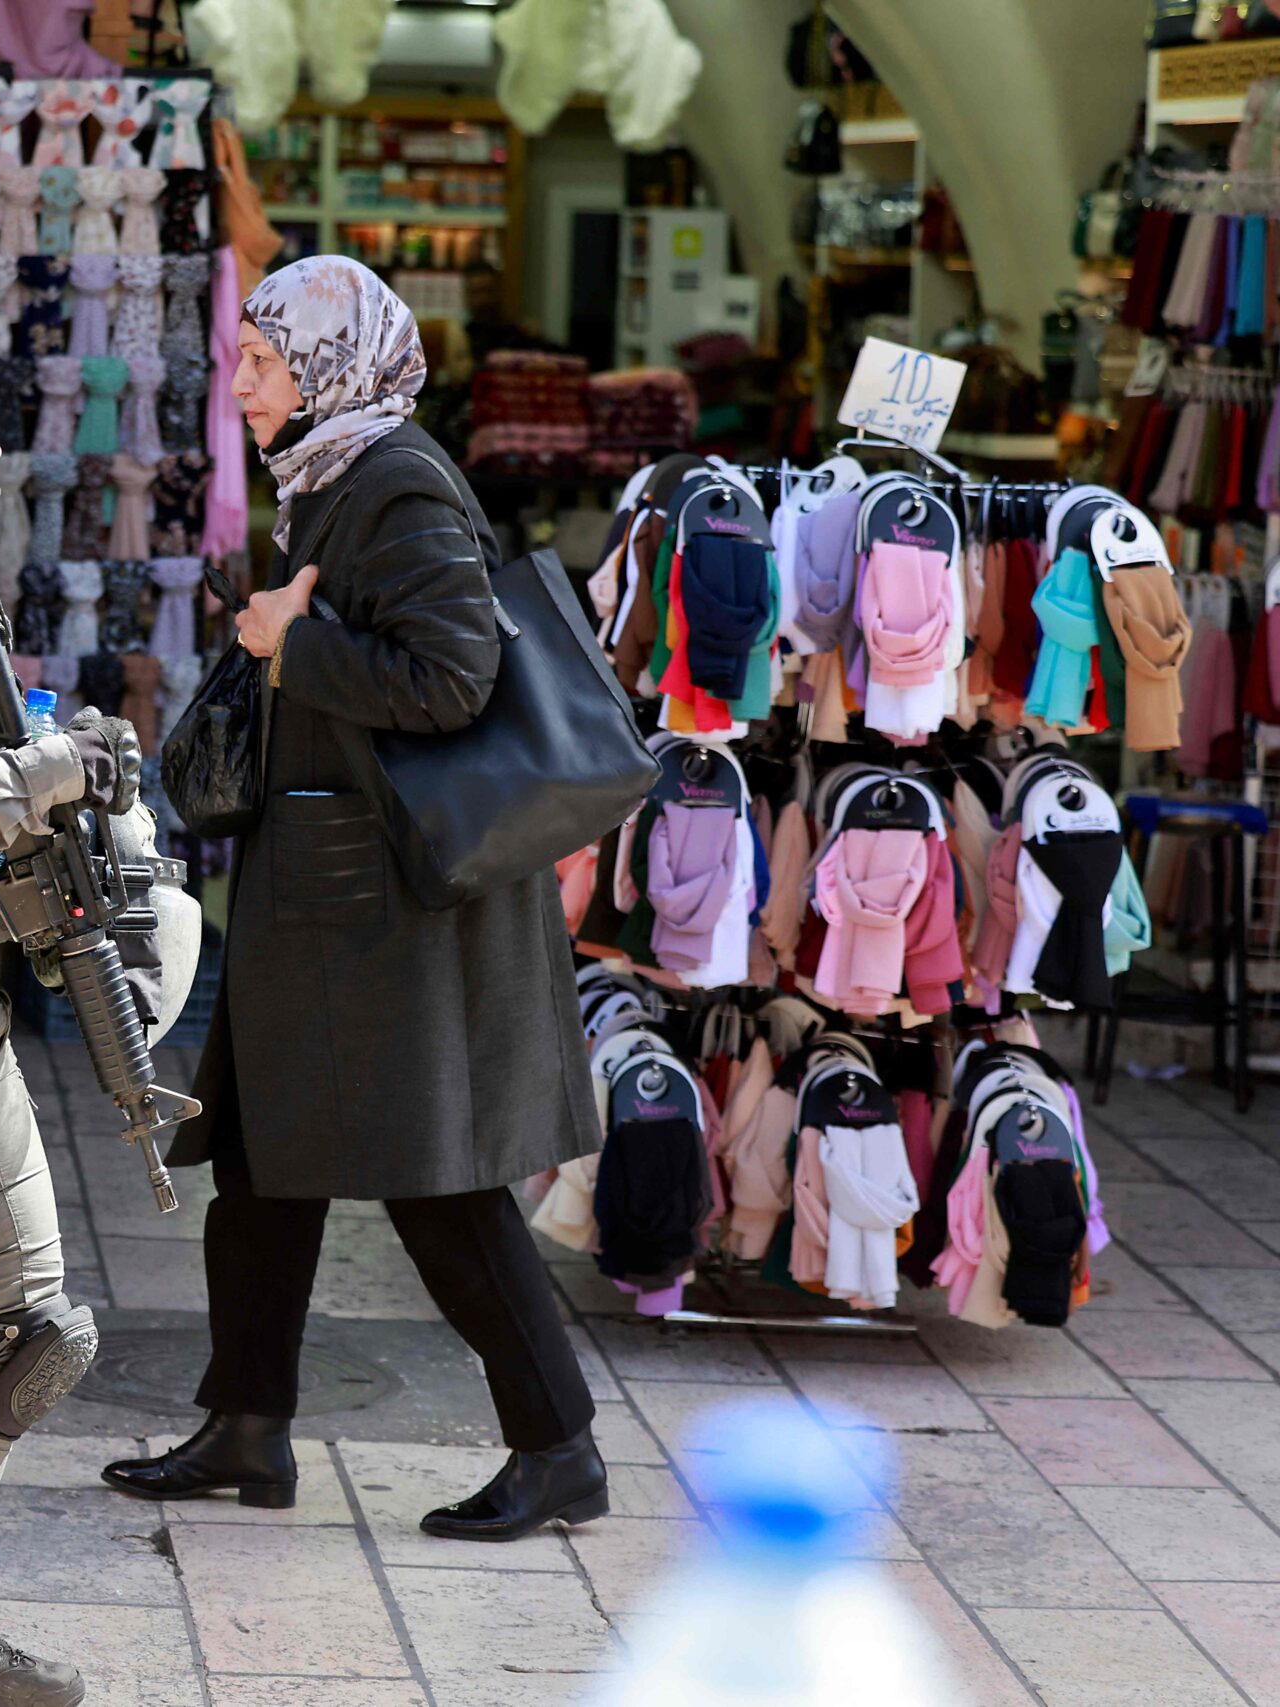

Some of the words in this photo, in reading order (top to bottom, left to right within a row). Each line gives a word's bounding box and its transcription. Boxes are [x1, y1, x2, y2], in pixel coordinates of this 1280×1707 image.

[881, 351, 932, 405] 10
[704, 515, 752, 533] Viano
[890, 523, 937, 547] Viano
[677, 782, 725, 799] Viano
